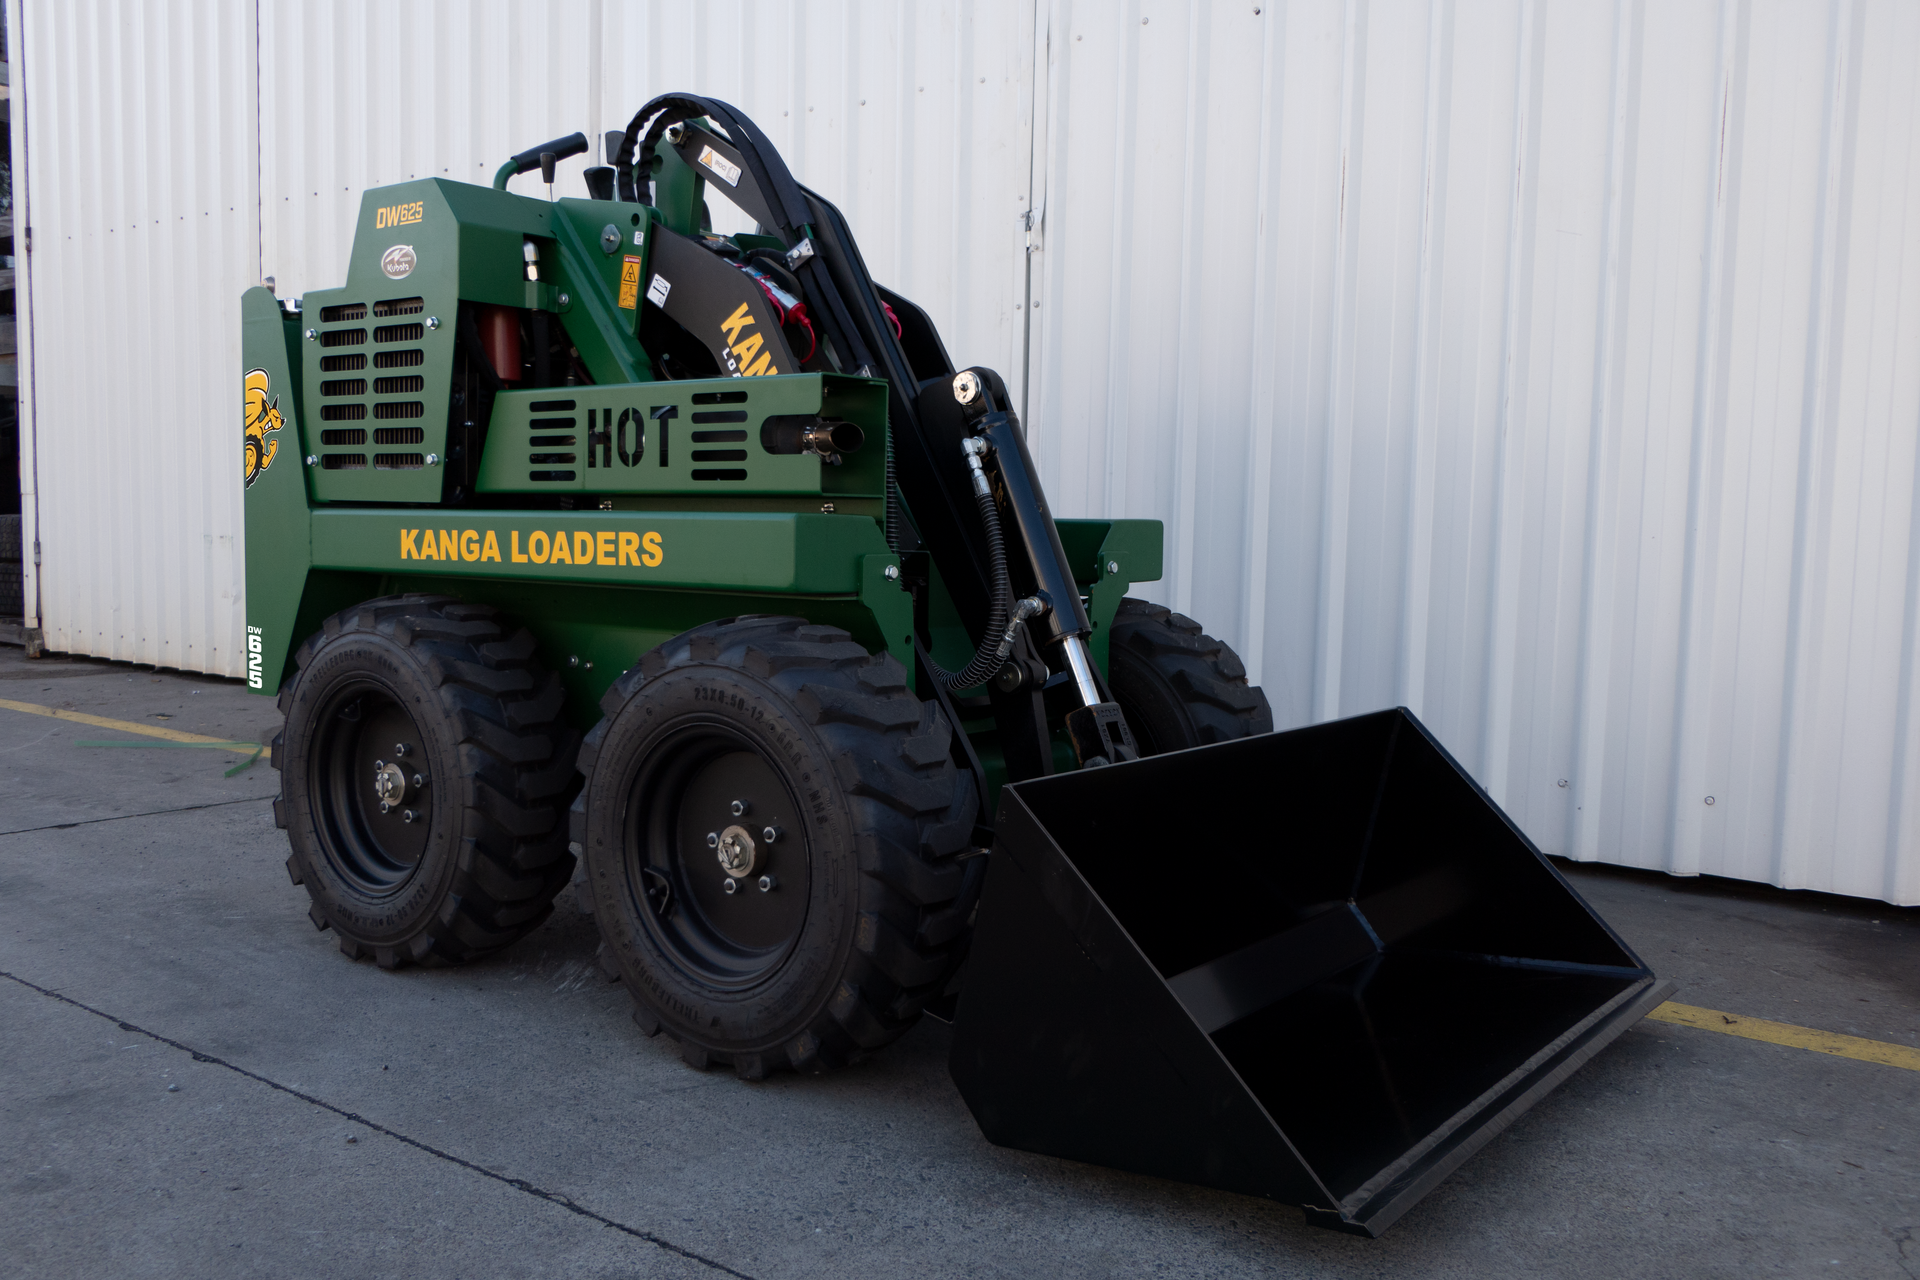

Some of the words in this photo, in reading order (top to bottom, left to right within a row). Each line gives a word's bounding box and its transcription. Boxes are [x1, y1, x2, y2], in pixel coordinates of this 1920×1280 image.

[376, 201, 423, 229] DW625
[387, 263, 409, 272] Kubota
[587, 405, 679, 468] HOT
[400, 529, 501, 562] KANGA
[511, 530, 663, 567] LOADERS
[247, 626, 262, 634] DW
[248, 634, 263, 689] 625
